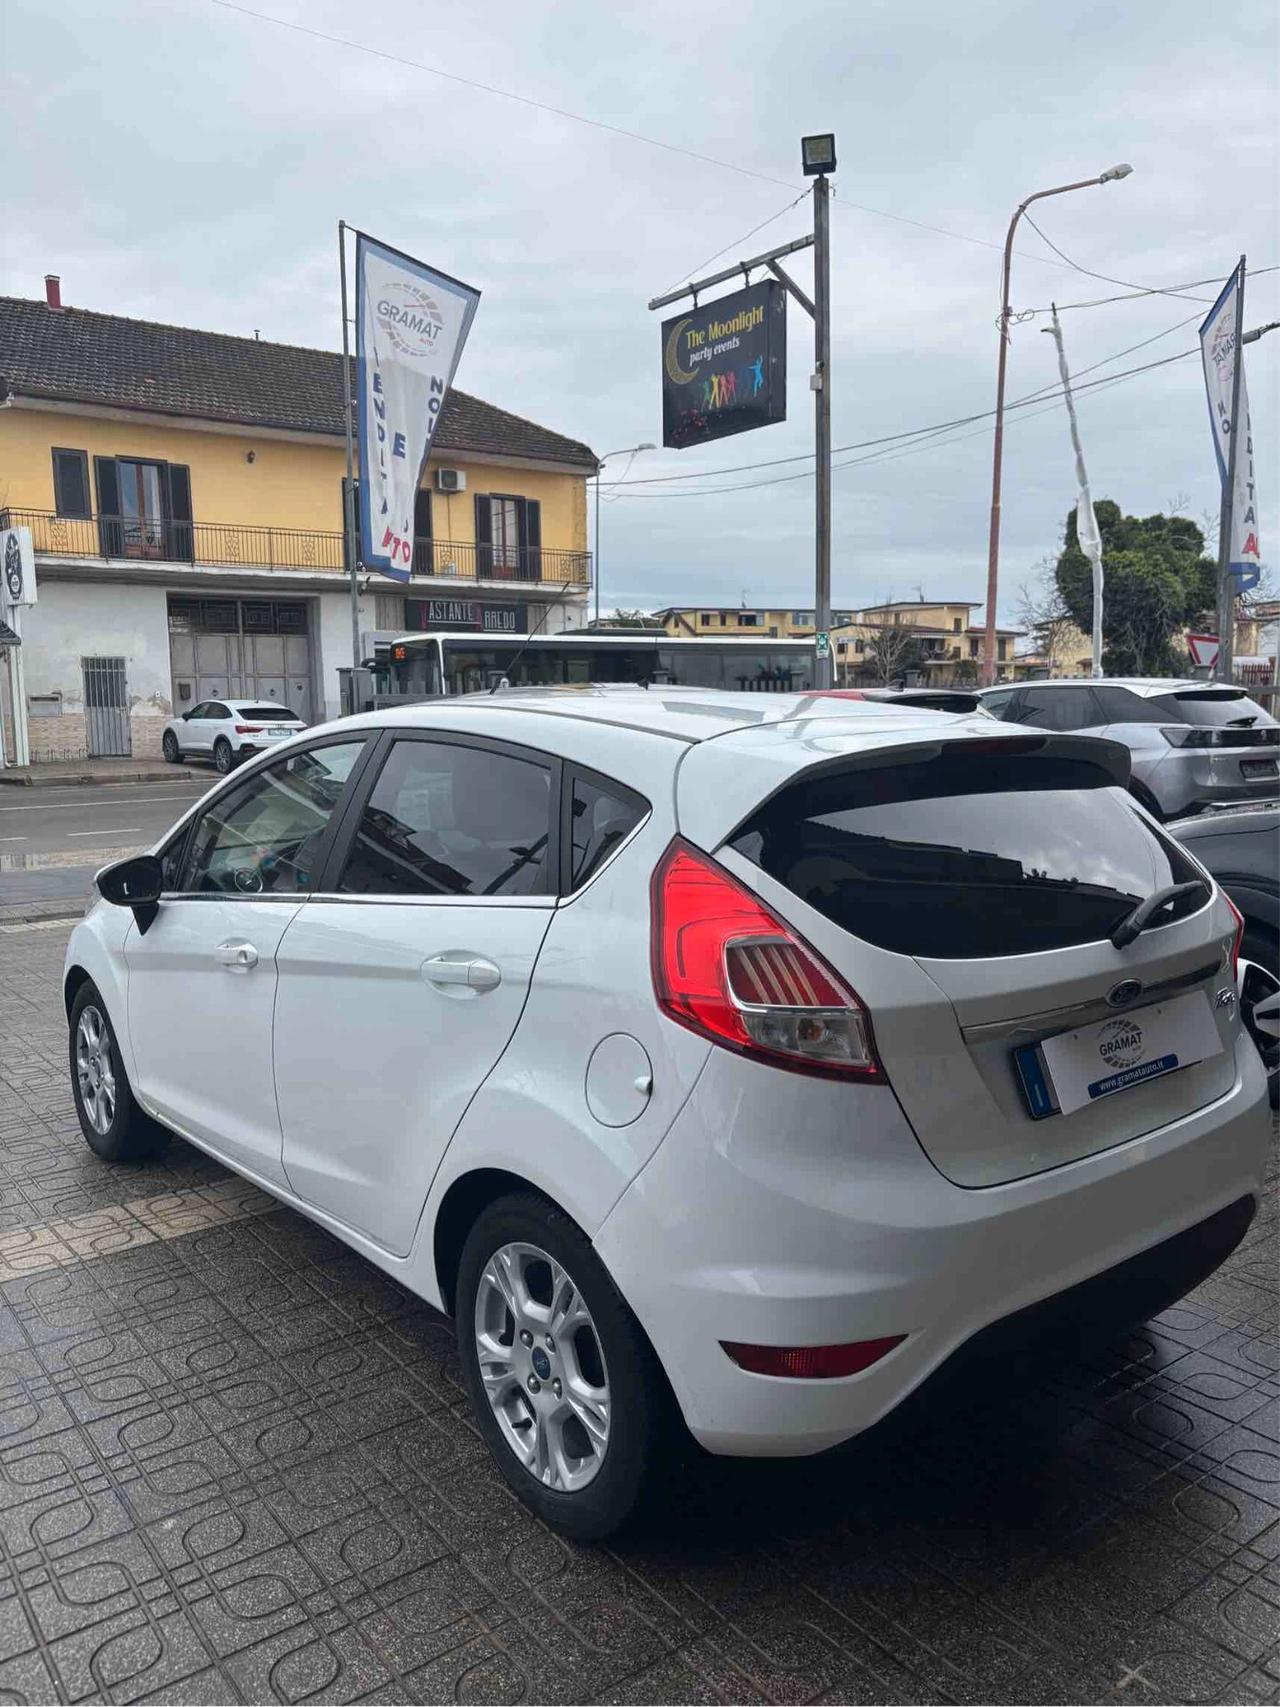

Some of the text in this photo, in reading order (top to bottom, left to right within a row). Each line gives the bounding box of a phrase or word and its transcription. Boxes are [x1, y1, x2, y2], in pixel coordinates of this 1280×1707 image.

[377, 300, 444, 340] GRAMAT
[686, 305, 764, 349] The Moonlight
[689, 336, 740, 368] party events
[1099, 1031, 1143, 1056] GRAMAT
[1099, 1058, 1165, 1091] www.gramatauto.it
